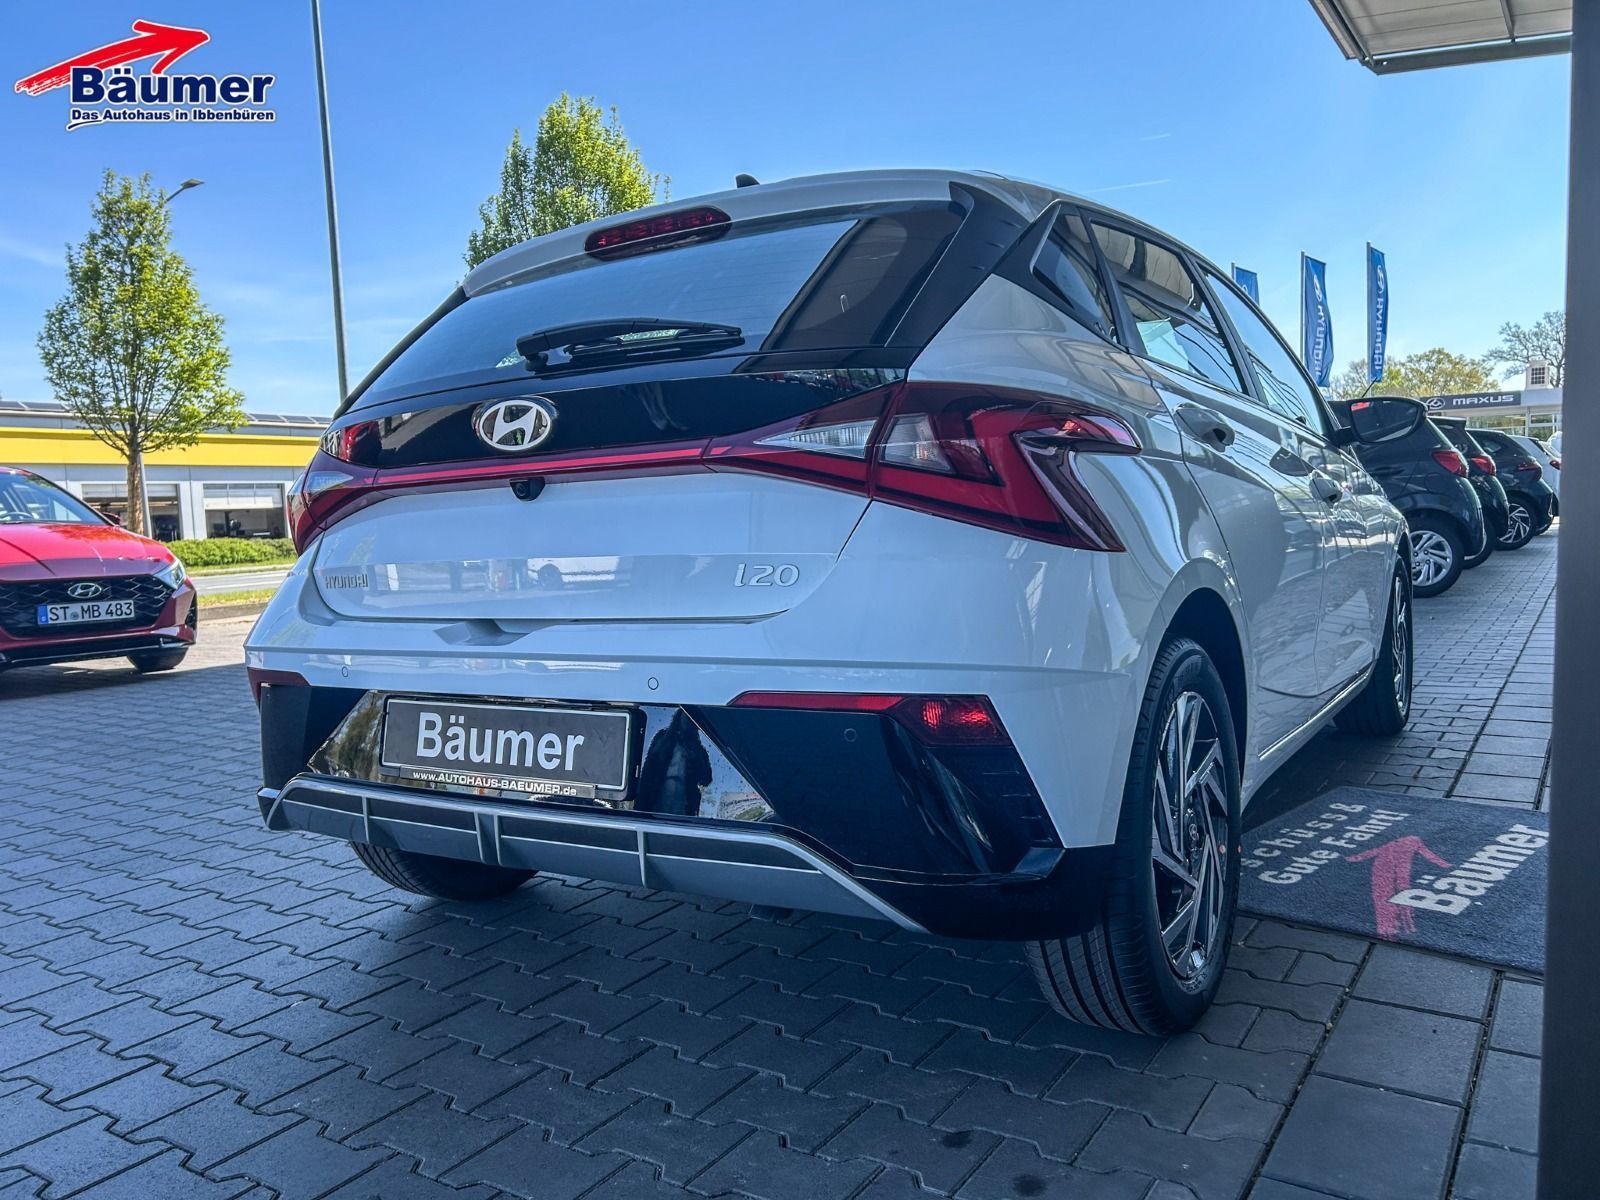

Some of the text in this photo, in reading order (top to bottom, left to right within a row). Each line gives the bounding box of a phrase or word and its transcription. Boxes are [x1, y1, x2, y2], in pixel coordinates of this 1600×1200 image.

[1312, 304, 1327, 377] HYUNDAI
[1373, 297, 1385, 371] HYUNDAI
[1452, 394, 1515, 406] MAXUS
[325, 573, 369, 590] HYUNDAI
[49, 602, 133, 622] ST MB 483
[416, 711, 585, 771] Bäumer
[412, 771, 577, 796] www.AUTOHAUS-BAEUMER.de
[1257, 849, 1340, 884] Gute
[1387, 823, 1550, 916] Bäumer
